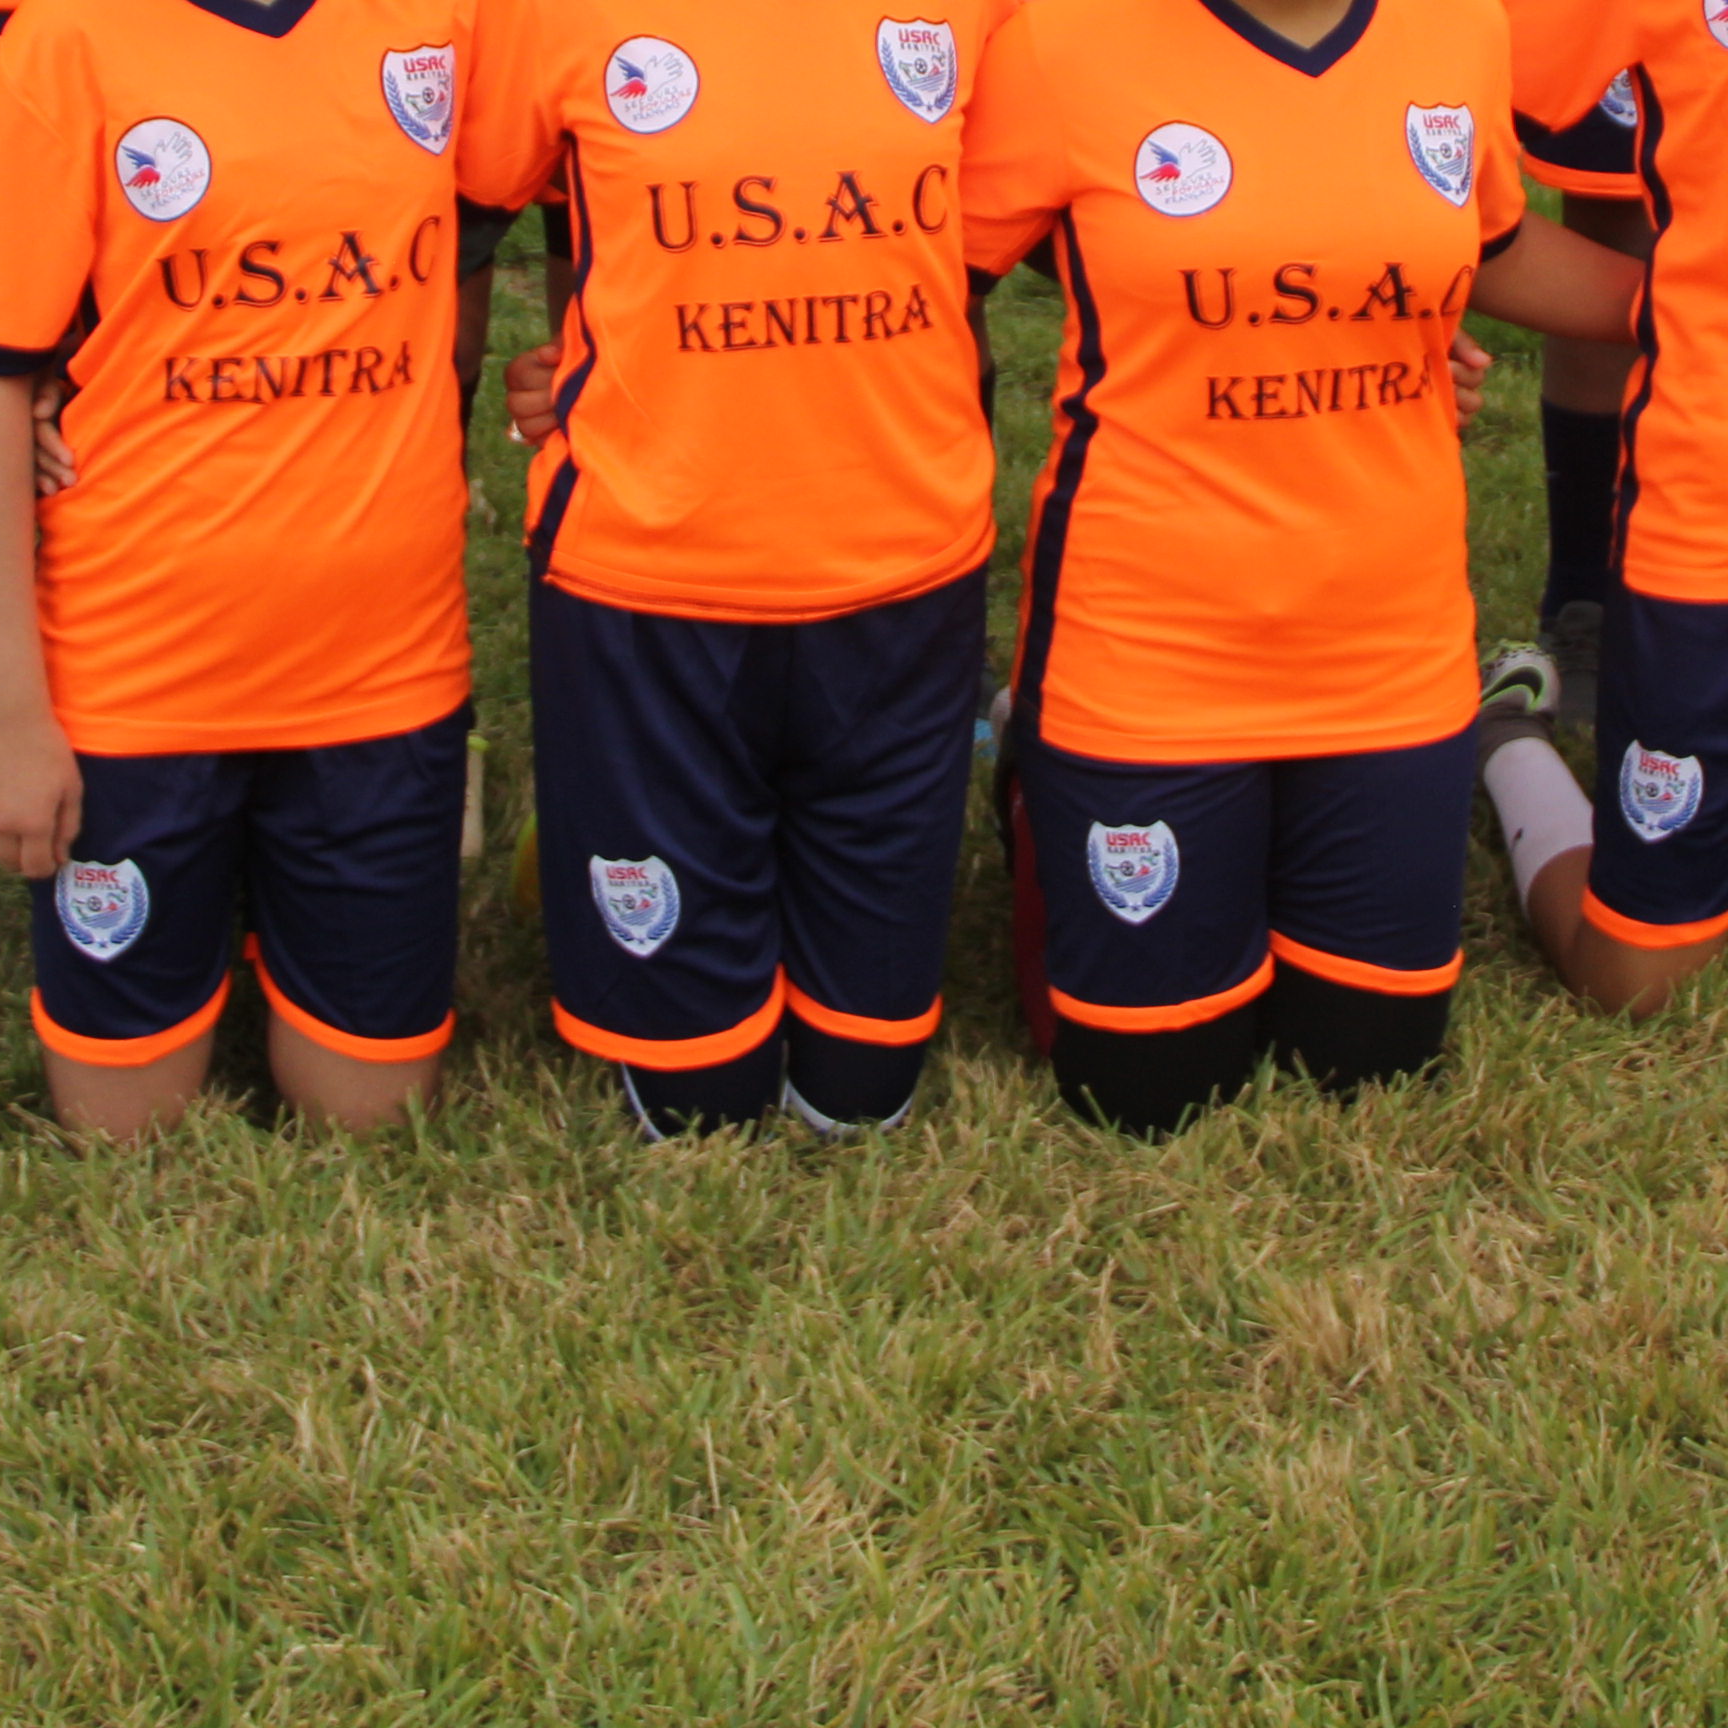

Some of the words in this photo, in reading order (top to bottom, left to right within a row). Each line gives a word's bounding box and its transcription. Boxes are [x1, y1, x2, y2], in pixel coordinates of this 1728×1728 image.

[647, 164, 948, 254] U.S.A.C
[157, 215, 441, 312] U.S.A.C
[674, 282, 935, 353] KENITRA
[164, 340, 415, 404] KENITRA
